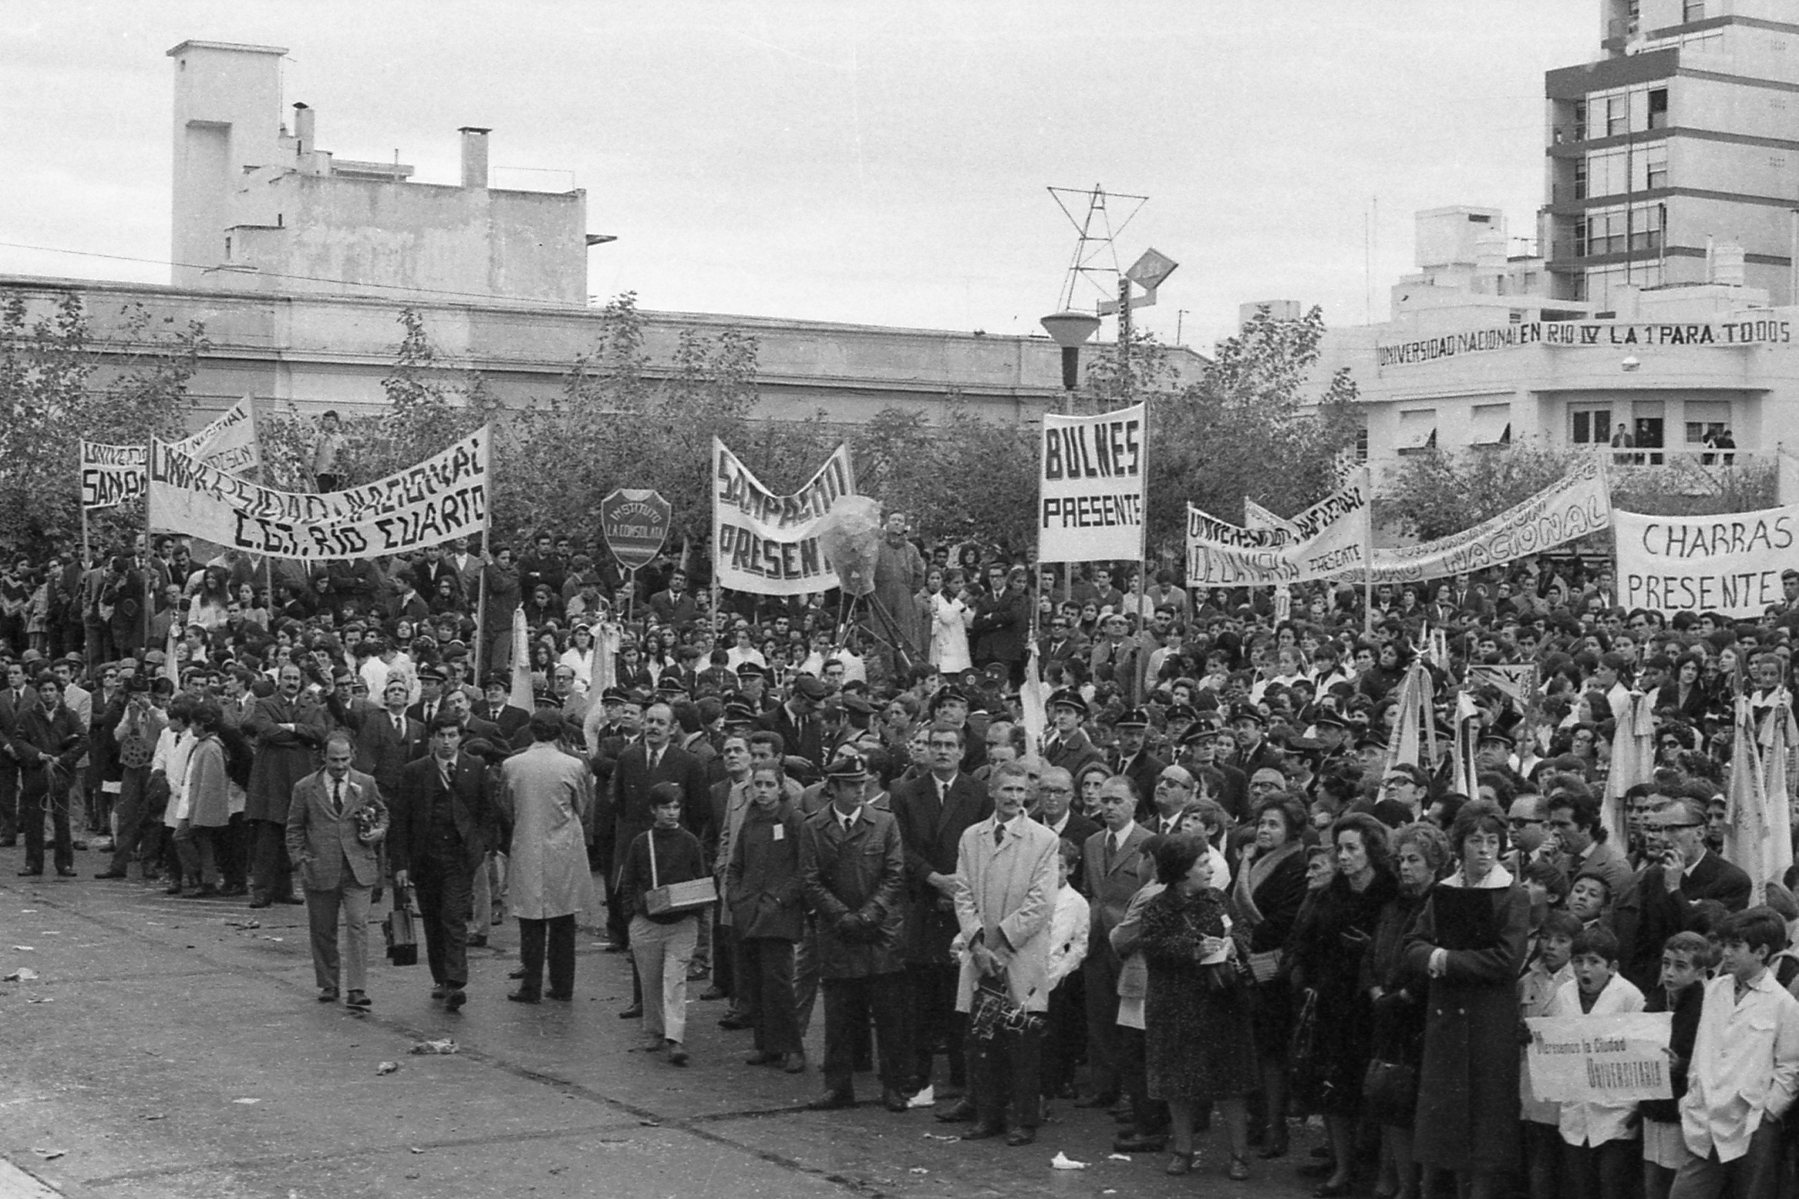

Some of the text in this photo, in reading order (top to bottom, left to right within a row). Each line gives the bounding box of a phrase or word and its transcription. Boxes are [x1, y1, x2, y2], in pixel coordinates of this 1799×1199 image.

[1379, 335, 1455, 366] UNIVERSIDAD
[1458, 327, 1518, 352] NACIONAL
[1520, 322, 1541, 344] EN
[1547, 323, 1574, 344] RIO
[1580, 325, 1601, 344] IV
[1610, 327, 1638, 344] LA
[1659, 325, 1715, 344] PARA
[1722, 321, 1790, 343] TODOS
[1046, 420, 1139, 481] BULNES
[343, 438, 485, 523] NACIONAL
[375, 484, 485, 550] CUARTO
[1043, 494, 1141, 529] PRESENTE
[1441, 494, 1608, 573] NACIONAL
[1643, 516, 1794, 558] CHARRAS
[1628, 570, 1777, 610] PRESENTE
